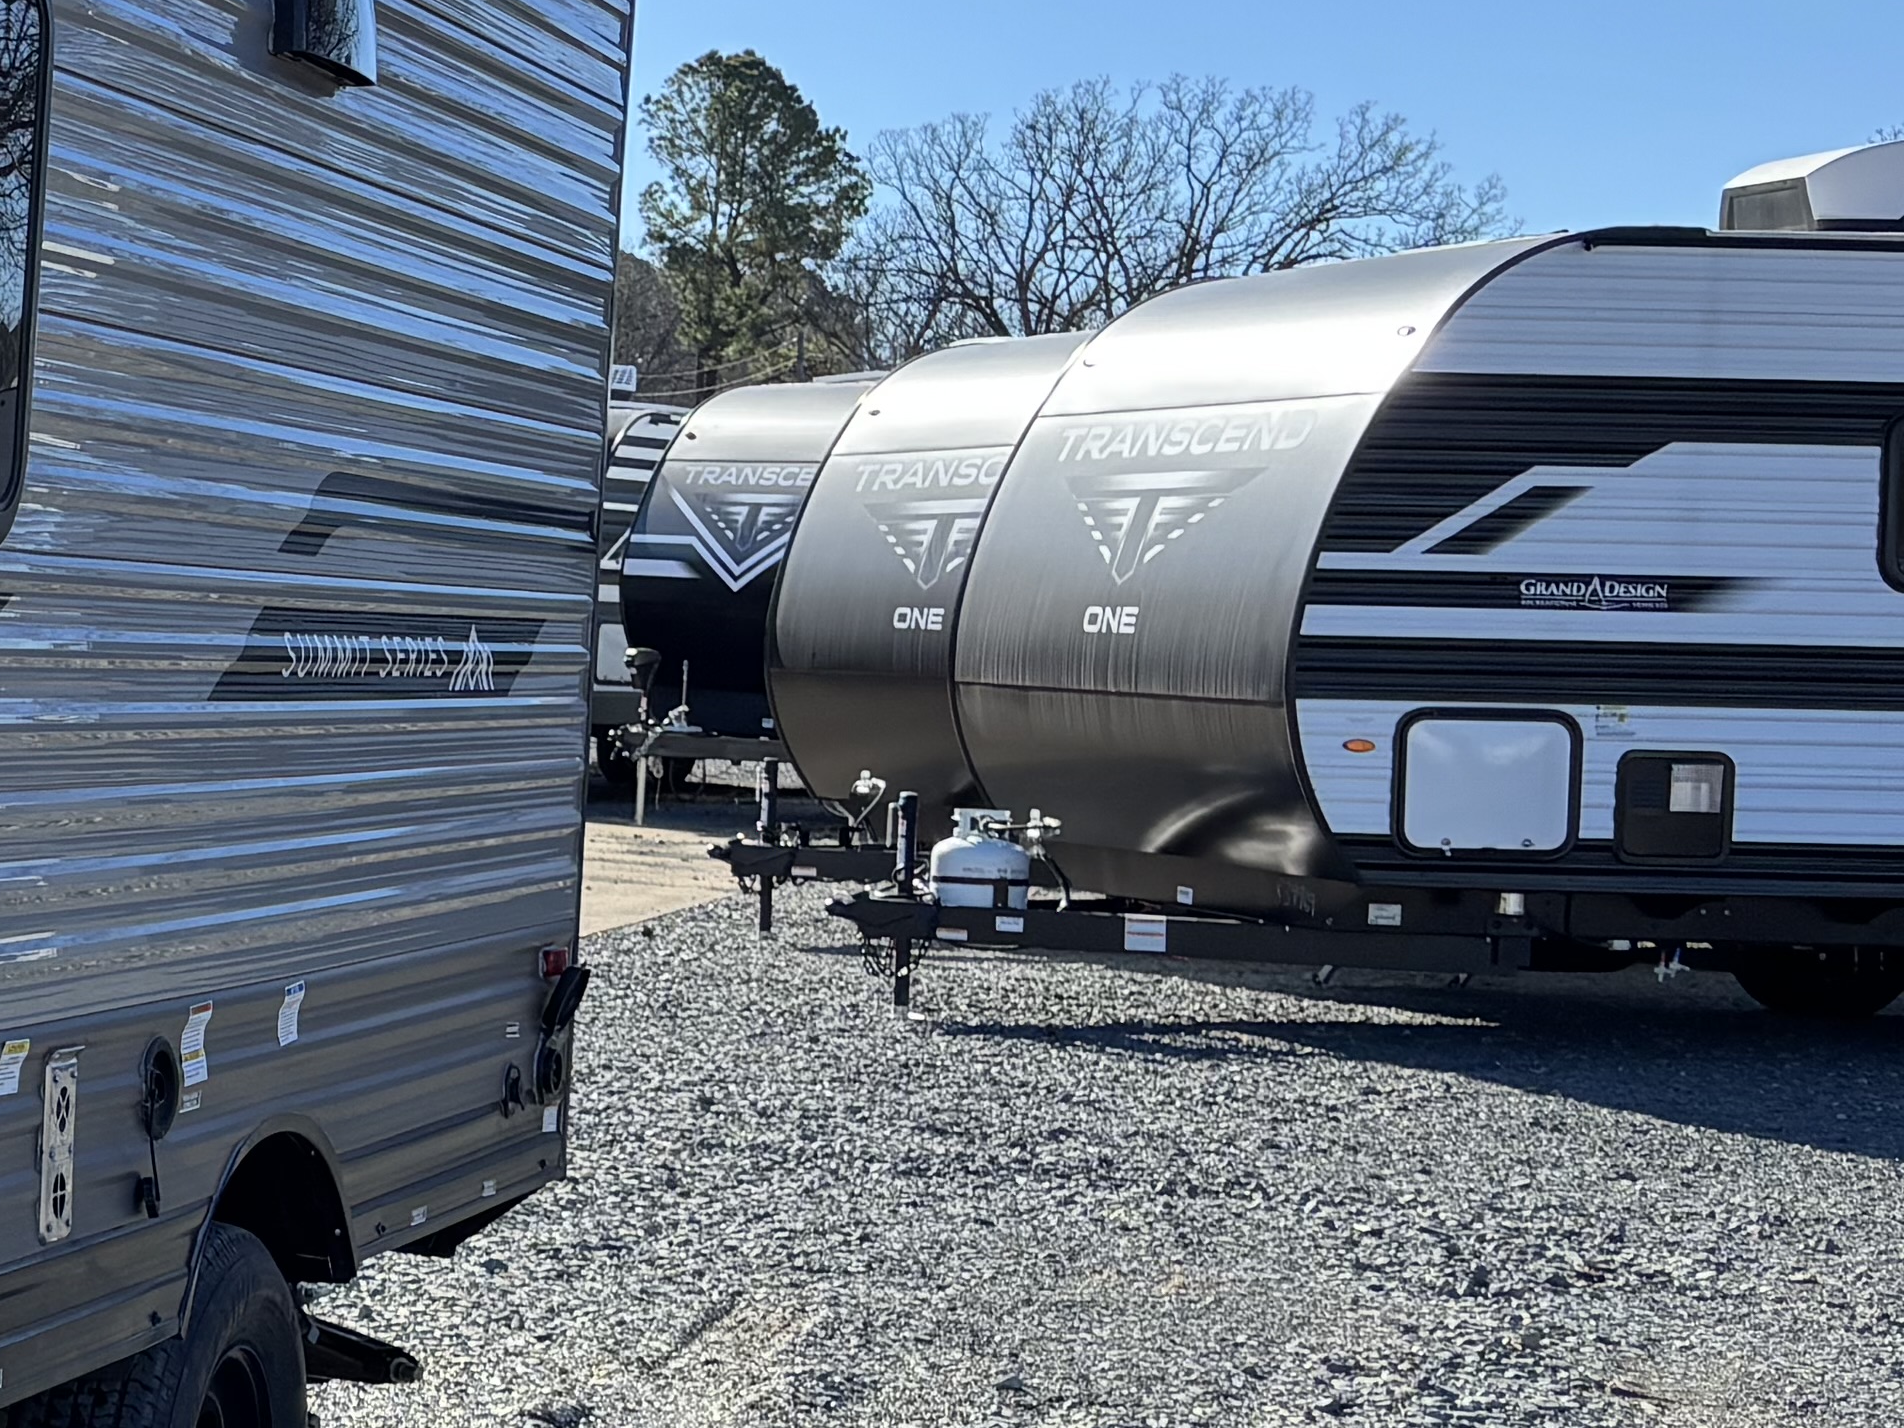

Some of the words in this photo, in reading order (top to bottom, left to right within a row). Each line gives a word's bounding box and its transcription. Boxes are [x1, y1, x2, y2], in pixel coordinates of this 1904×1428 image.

[1058, 410, 1317, 462] TRANSCEND
[1520, 579, 1586, 596] GRAND
[1604, 581, 1668, 597] DESIGN
[893, 607, 945, 630] ONE
[1082, 606, 1139, 634] ONE
[282, 632, 370, 677] SUMMIT
[379, 635, 448, 677] SERIES
